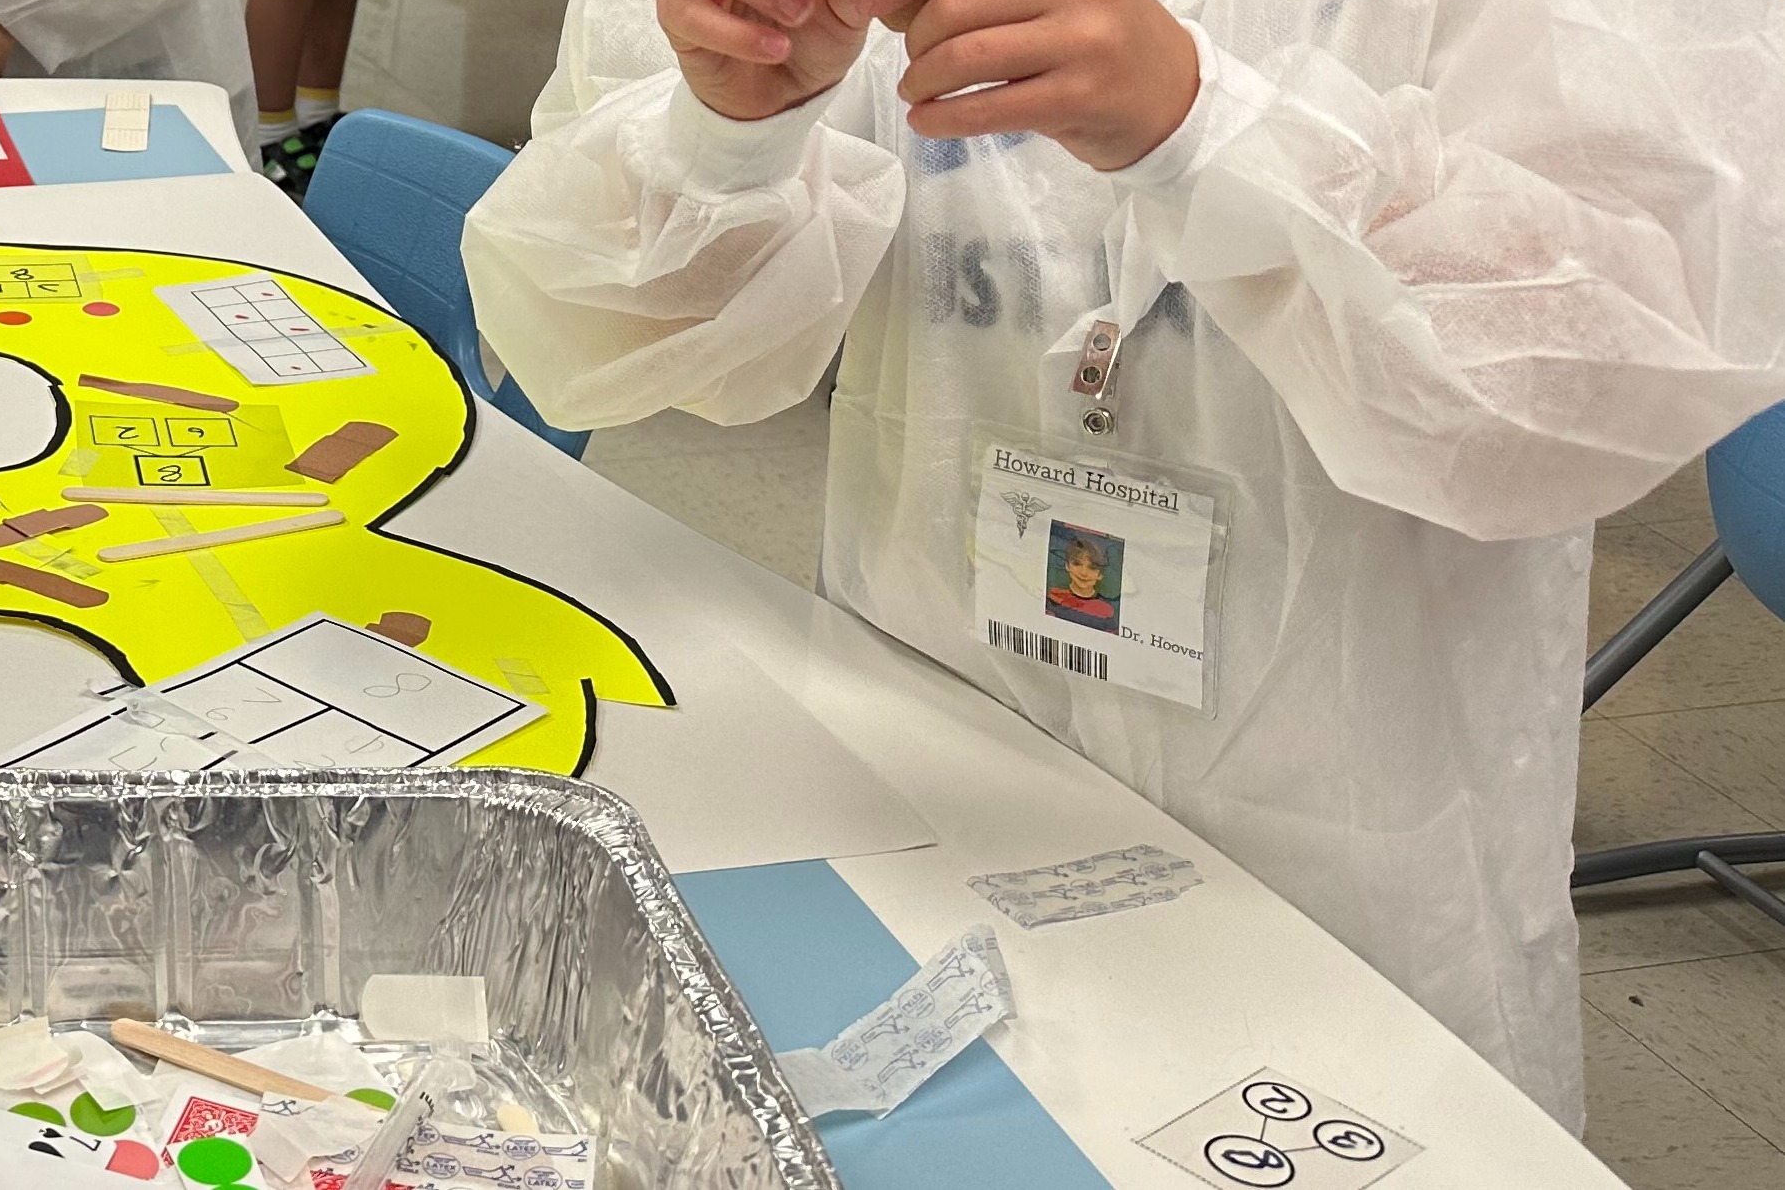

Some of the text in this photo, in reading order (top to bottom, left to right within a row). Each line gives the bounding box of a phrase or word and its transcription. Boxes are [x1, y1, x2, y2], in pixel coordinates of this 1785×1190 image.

[114, 425, 141, 440] 2
[993, 449, 1180, 511] Howard Hospital
[1120, 626, 1204, 661] Dr. Hoover
[1260, 1085, 1295, 1114] 2
[506, 1144, 536, 1152] LATEX
[426, 1161, 456, 1171] LATEX
[527, 1178, 557, 1188] LATEX
